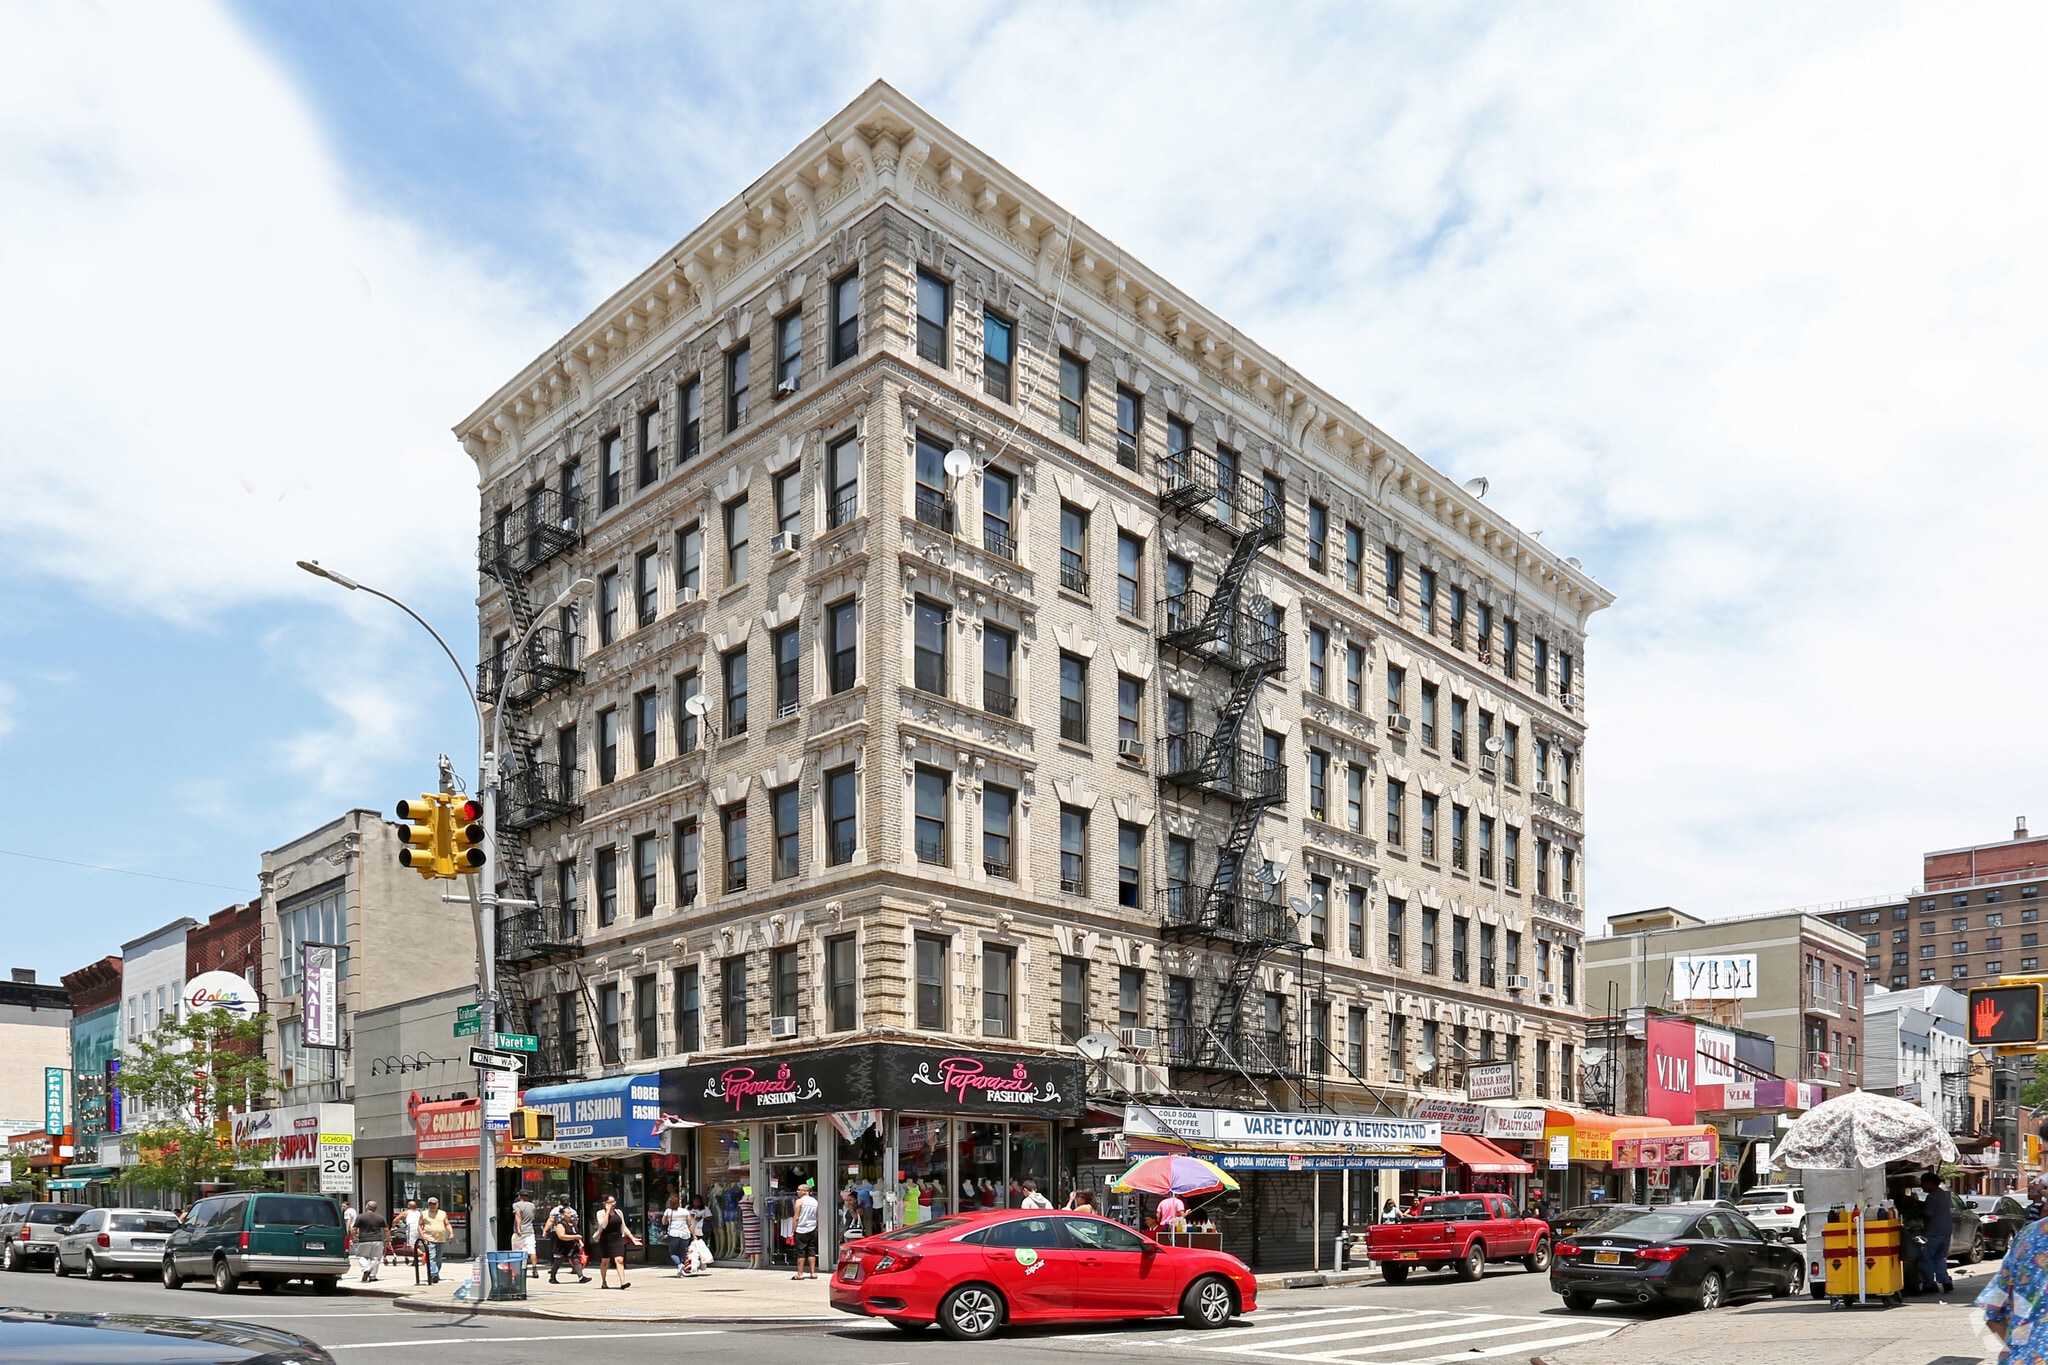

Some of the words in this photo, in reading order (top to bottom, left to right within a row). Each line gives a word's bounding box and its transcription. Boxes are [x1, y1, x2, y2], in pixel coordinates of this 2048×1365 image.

[1680, 959, 1752, 990] VIM
[191, 988, 239, 1007] Color
[308, 980, 319, 1043] NAILS
[500, 1036, 523, 1048] Varet
[478, 1054, 494, 1064] ONE
[501, 1058, 517, 1068] WAY
[1480, 1067, 1501, 1075] LUGO
[1656, 1054, 1691, 1094] V.I.M.
[939, 1057, 1033, 1104] Paparazzi
[1472, 1077, 1494, 1087] BARBER
[1496, 1075, 1511, 1084] SHOP
[721, 1067, 796, 1112] Paparazzi
[986, 1090, 1034, 1103] FASHION
[1472, 1088, 1491, 1098] BEAUTY
[1493, 1085, 1511, 1096] SALON
[49, 1077, 61, 1134] PHARMACY
[757, 1091, 797, 1106] FASHION
[575, 1097, 622, 1122] FASHION
[1428, 1104, 1447, 1112] LUGO
[1513, 1110, 1532, 1120] LUGO
[433, 1112, 465, 1133] GOLDEN
[1173, 1119, 1199, 1127] COFFEE
[1420, 1111, 1454, 1121] BARBER
[1457, 1114, 1480, 1123] SHOP
[1498, 1117, 1522, 1131] BEAUTY
[1523, 1119, 1543, 1131] SALON
[577, 1126, 591, 1134] SPOT
[1244, 1117, 1291, 1135] VARET
[1294, 1120, 1340, 1136] CANDY
[1343, 1121, 1352, 1137] &
[1356, 1121, 1426, 1139] NEWSSTAND
[279, 1132, 318, 1161] SUPPLY
[573, 1141, 592, 1149] CLOTHES
[324, 1160, 350, 1173] 20
[536, 1157, 560, 1165] GOLD
[1240, 1157, 1254, 1167] SODA
[1256, 1157, 1267, 1167] HOT
[1267, 1158, 1286, 1167] COFFEE
[1364, 1158, 1380, 1167] PHONE
[1380, 1158, 1394, 1167] CARDS
[1648, 1168, 1670, 1188] 50
[1025, 1259, 1045, 1276] zipcar
